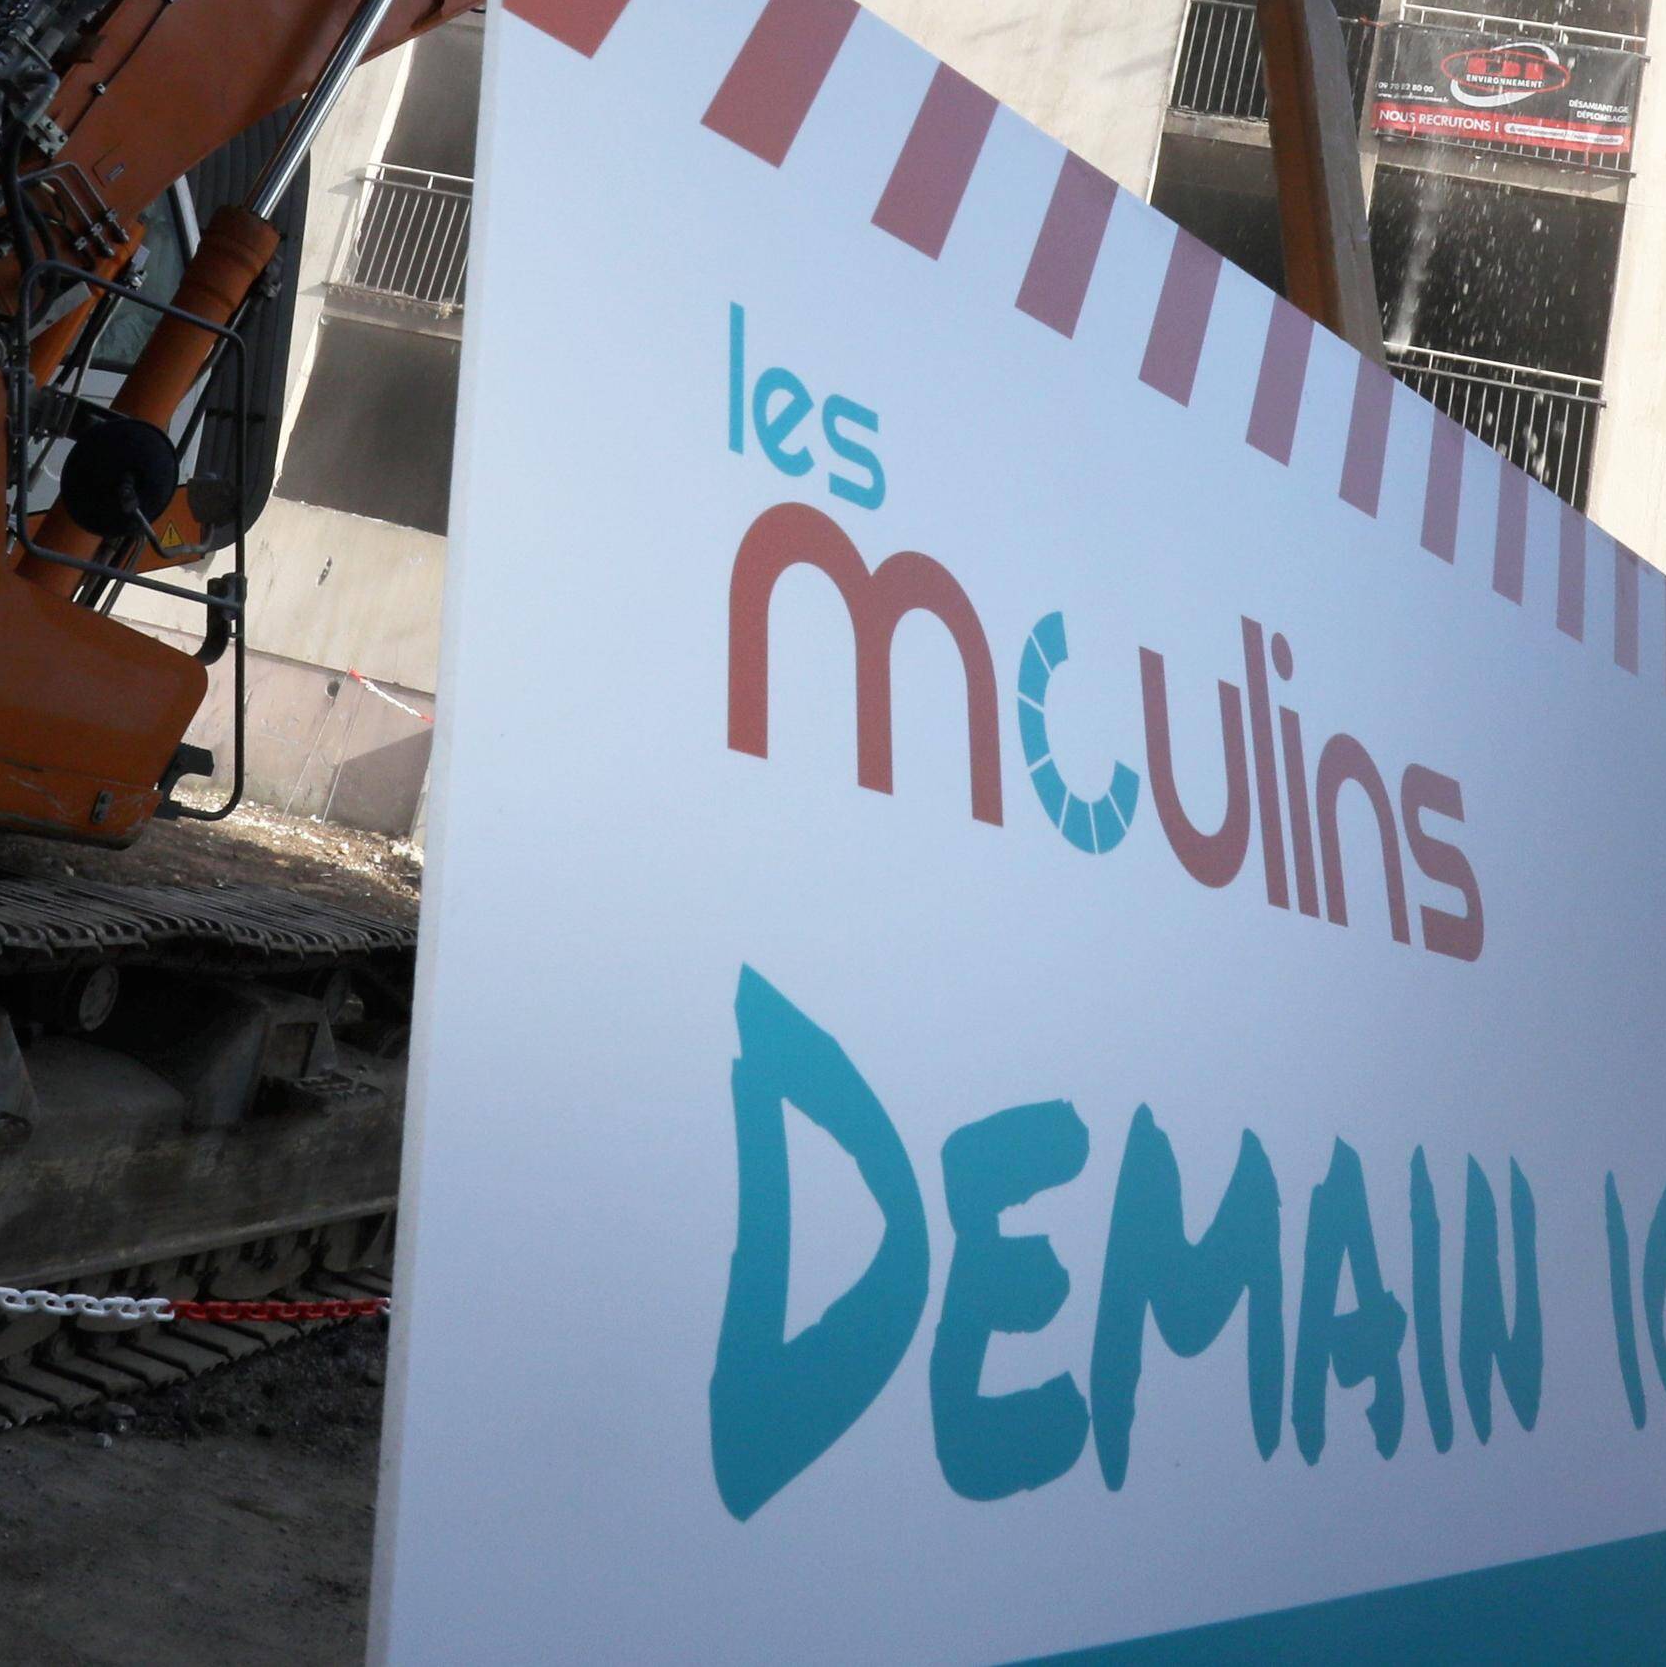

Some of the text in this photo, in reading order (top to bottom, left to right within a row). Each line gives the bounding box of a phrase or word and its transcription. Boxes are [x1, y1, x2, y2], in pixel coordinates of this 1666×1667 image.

[1423, 84, 1435, 93] 00
[1465, 73, 1543, 88] ENVIRONNEMENT
[1568, 99, 1630, 114] DÉSAMIANTAGE
[1379, 109, 1416, 123] NOUS
[1418, 112, 1492, 132] RECRUTONS
[727, 301, 887, 511] les
[707, 962, 1543, 1523] DEMAIN
